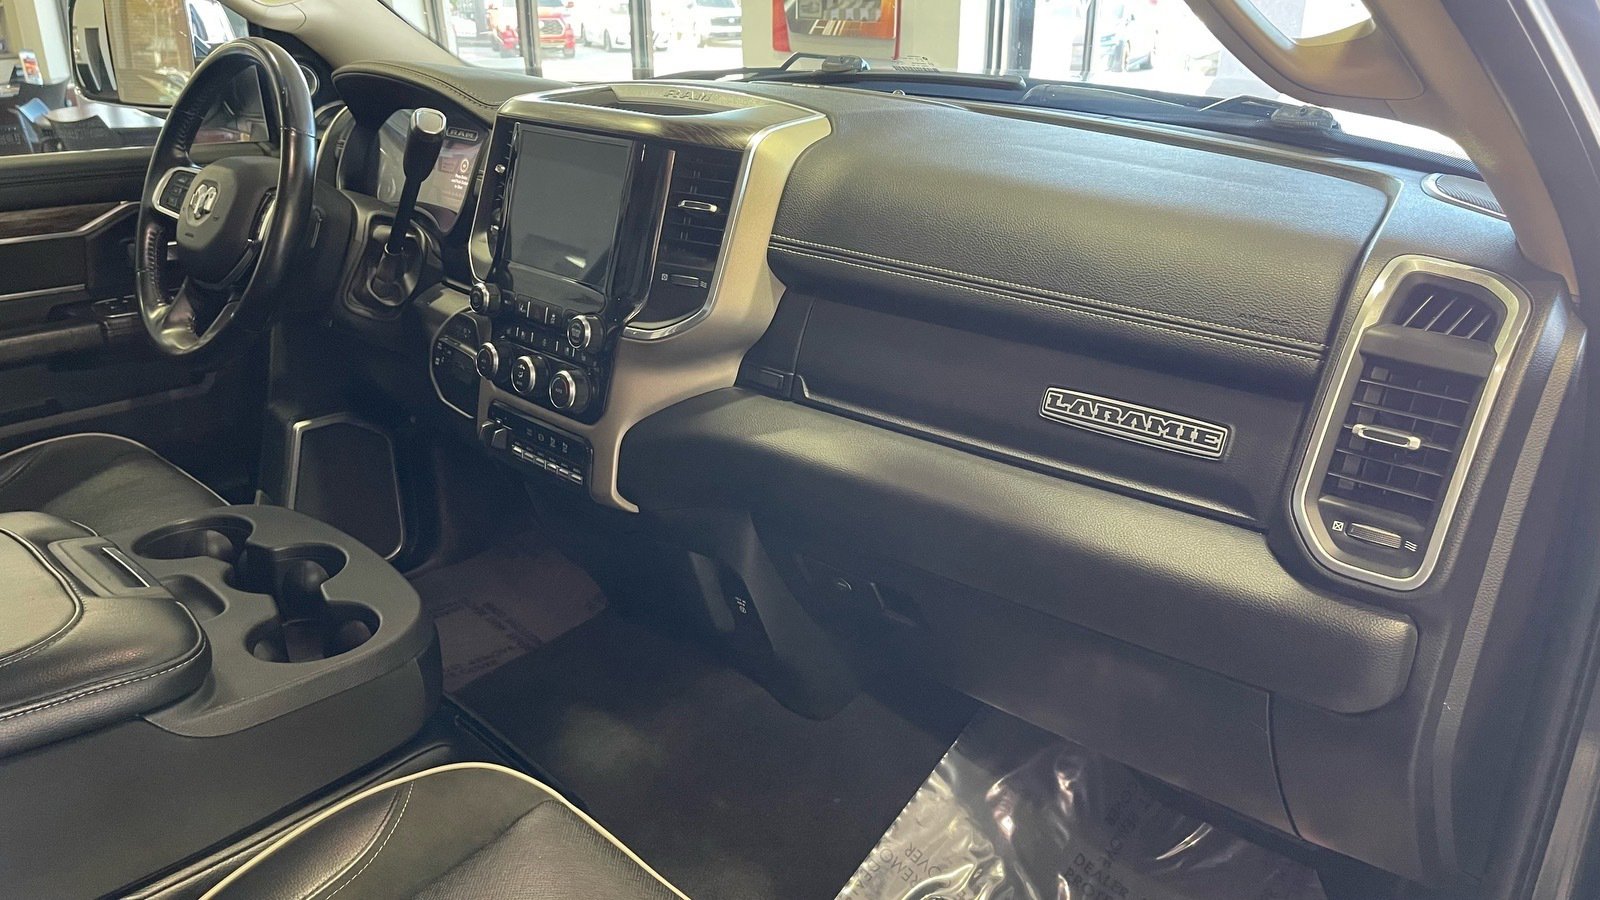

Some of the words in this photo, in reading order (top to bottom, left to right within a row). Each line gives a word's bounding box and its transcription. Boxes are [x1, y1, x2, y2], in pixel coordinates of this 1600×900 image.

[663, 88, 712, 102] RAM
[449, 129, 475, 139] RAM
[1048, 393, 1222, 447] LARAMIE
